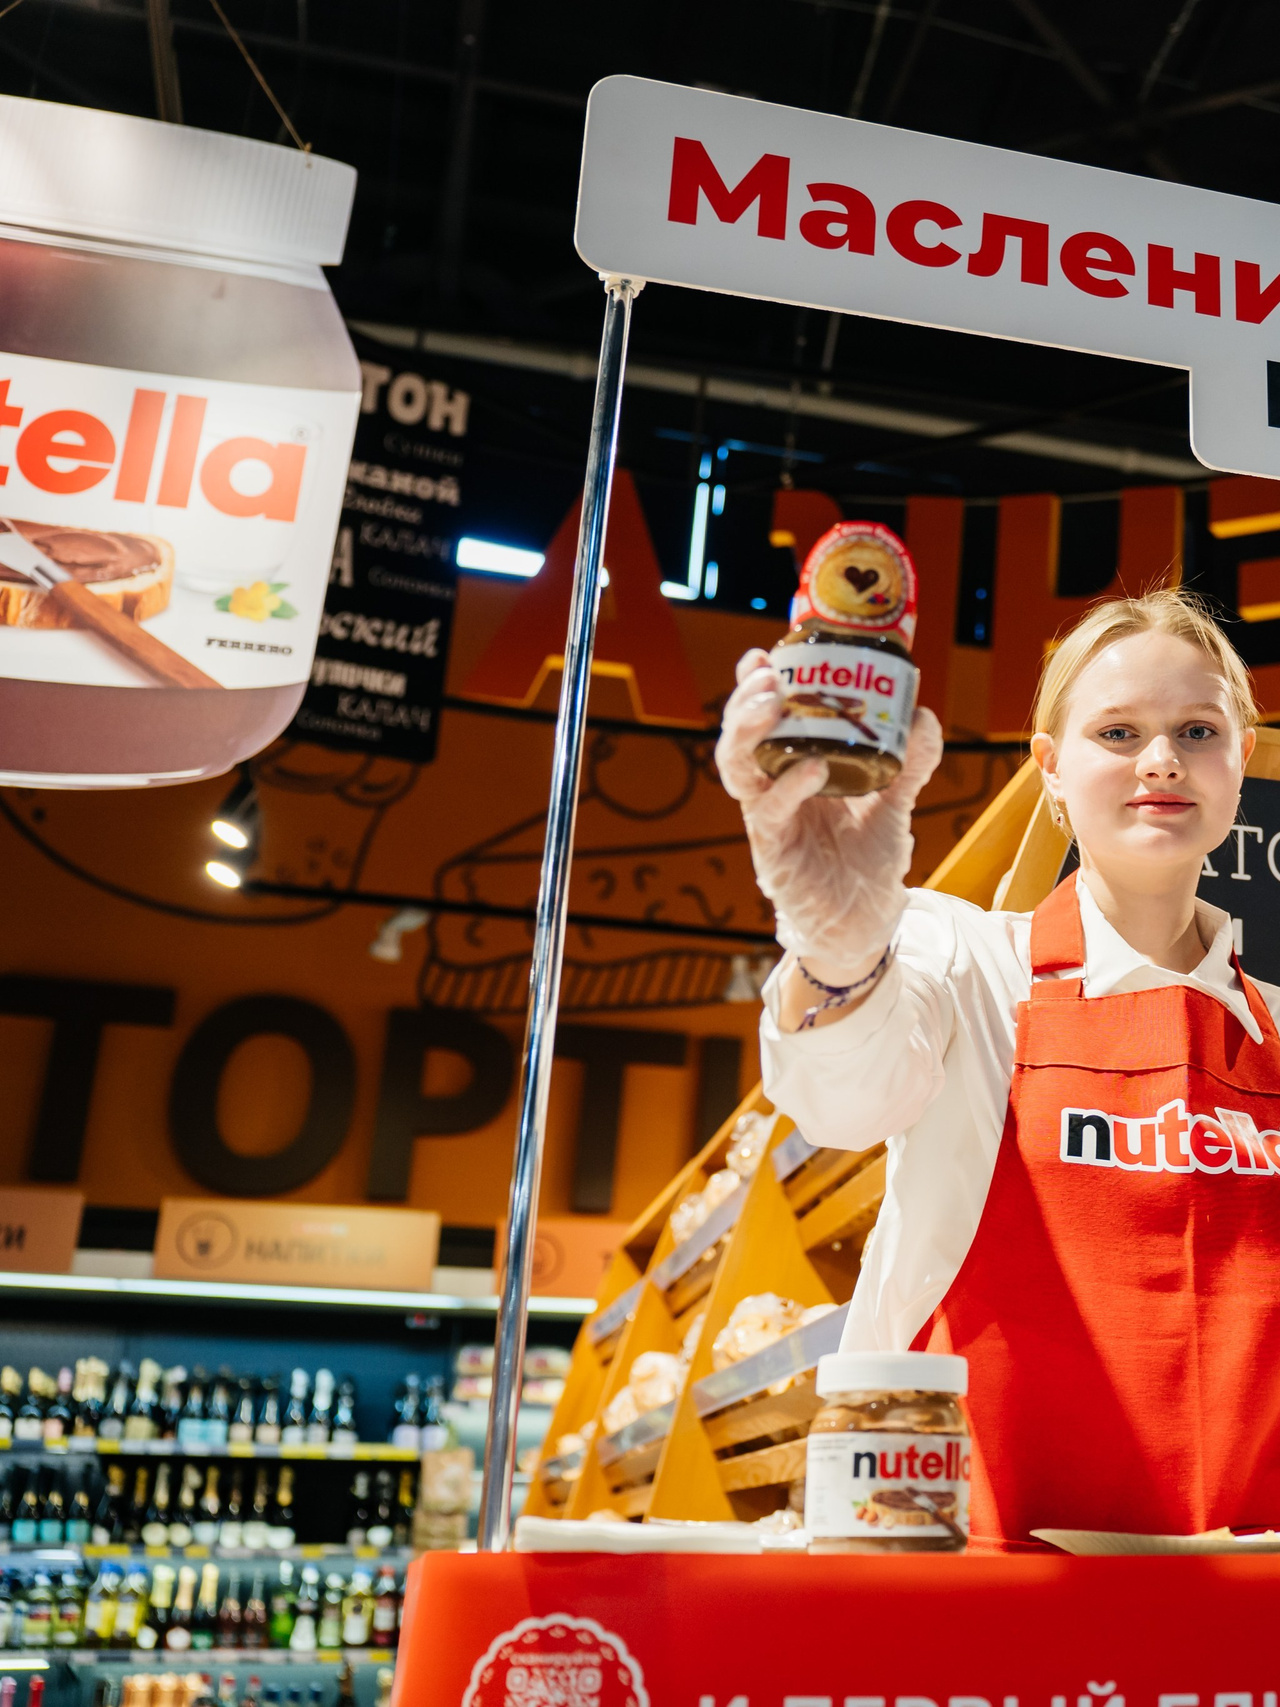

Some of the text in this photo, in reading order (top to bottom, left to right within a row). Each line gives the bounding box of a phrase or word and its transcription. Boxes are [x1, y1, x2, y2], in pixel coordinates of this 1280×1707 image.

[360, 360, 471, 437] ТОН
[0, 379, 307, 523] ella
[205, 637, 293, 655] FERRERO
[780, 662, 895, 697] nutella
[0, 975, 743, 1214] ТОРТ
